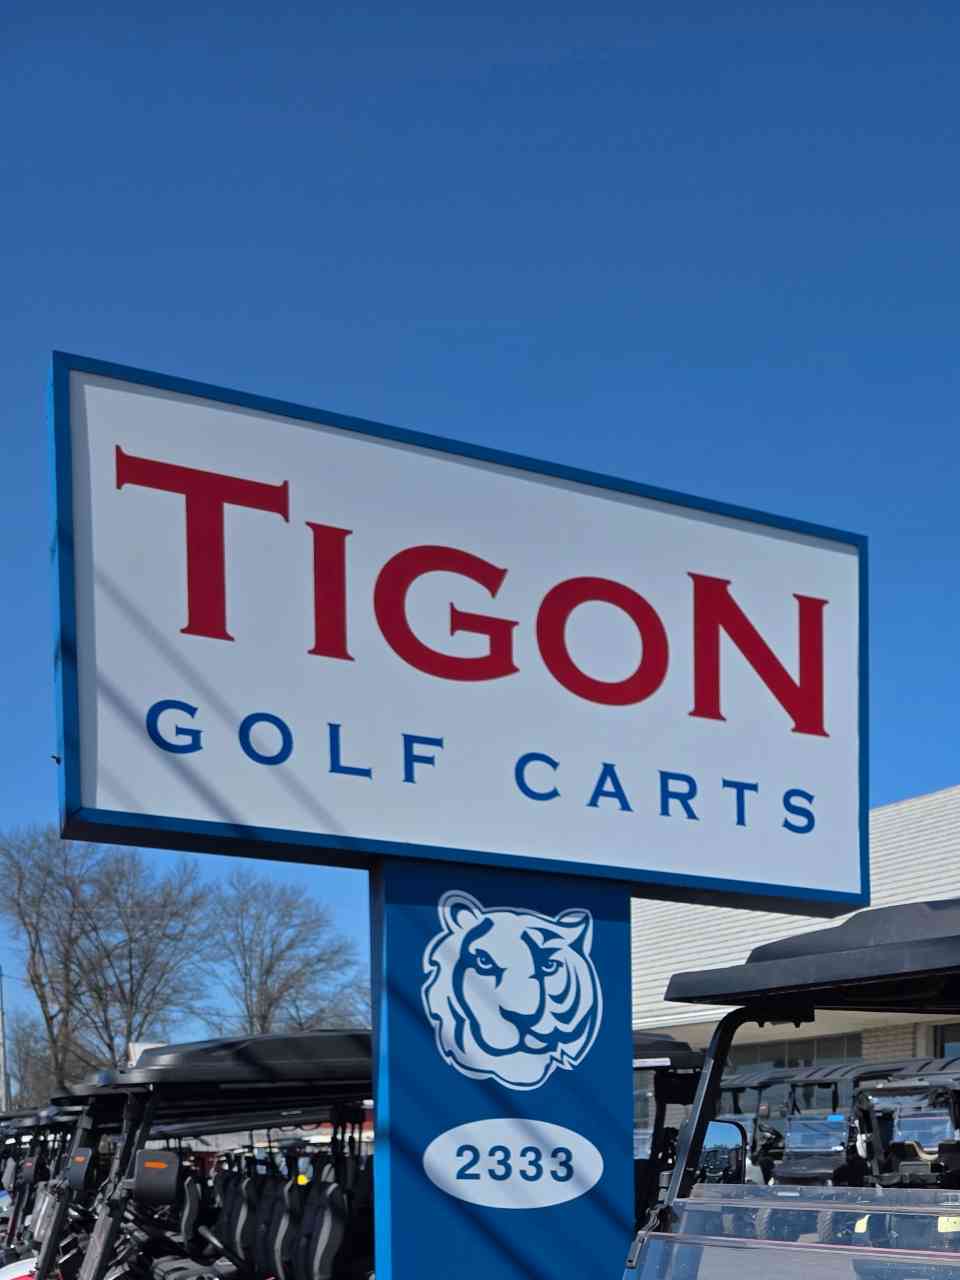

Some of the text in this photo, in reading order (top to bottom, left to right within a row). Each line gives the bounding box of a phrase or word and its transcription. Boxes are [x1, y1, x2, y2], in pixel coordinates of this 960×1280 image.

[115, 445, 830, 737] TIGON
[145, 699, 817, 834] GOLF CARTS
[455, 1144, 575, 1182] 2333
